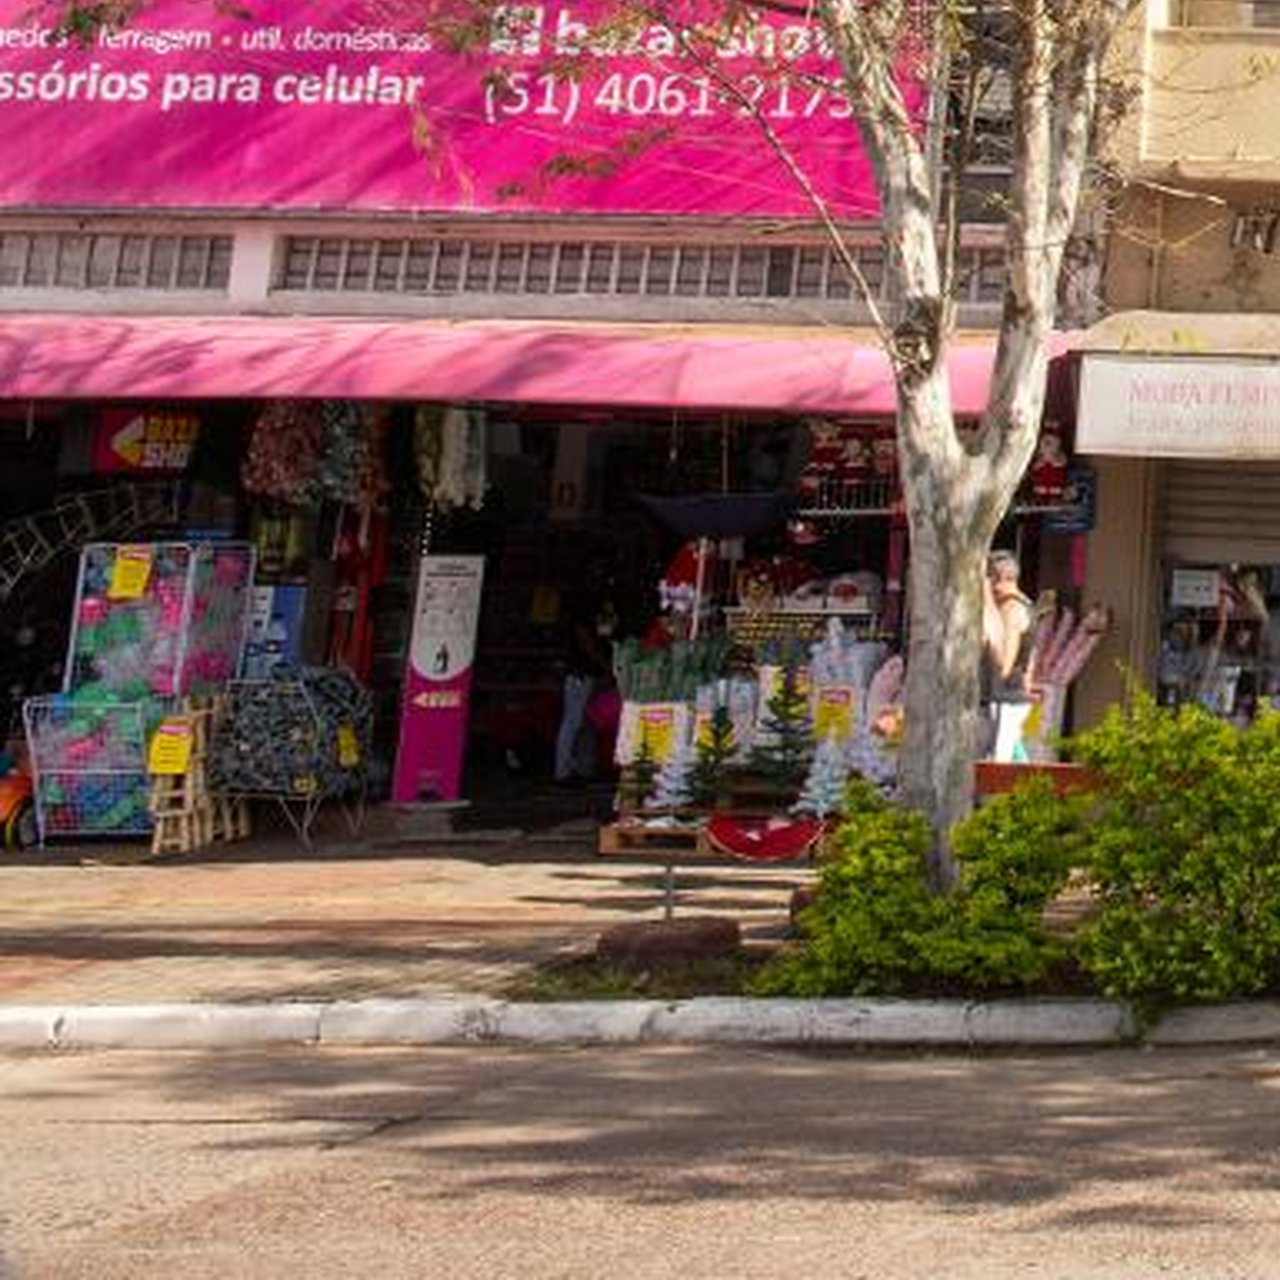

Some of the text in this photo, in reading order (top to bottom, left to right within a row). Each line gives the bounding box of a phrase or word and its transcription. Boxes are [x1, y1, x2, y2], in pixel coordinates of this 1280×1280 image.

[160, 71, 260, 111] para
[273, 65, 426, 106] celular
[485, 70, 581, 124] (51)
